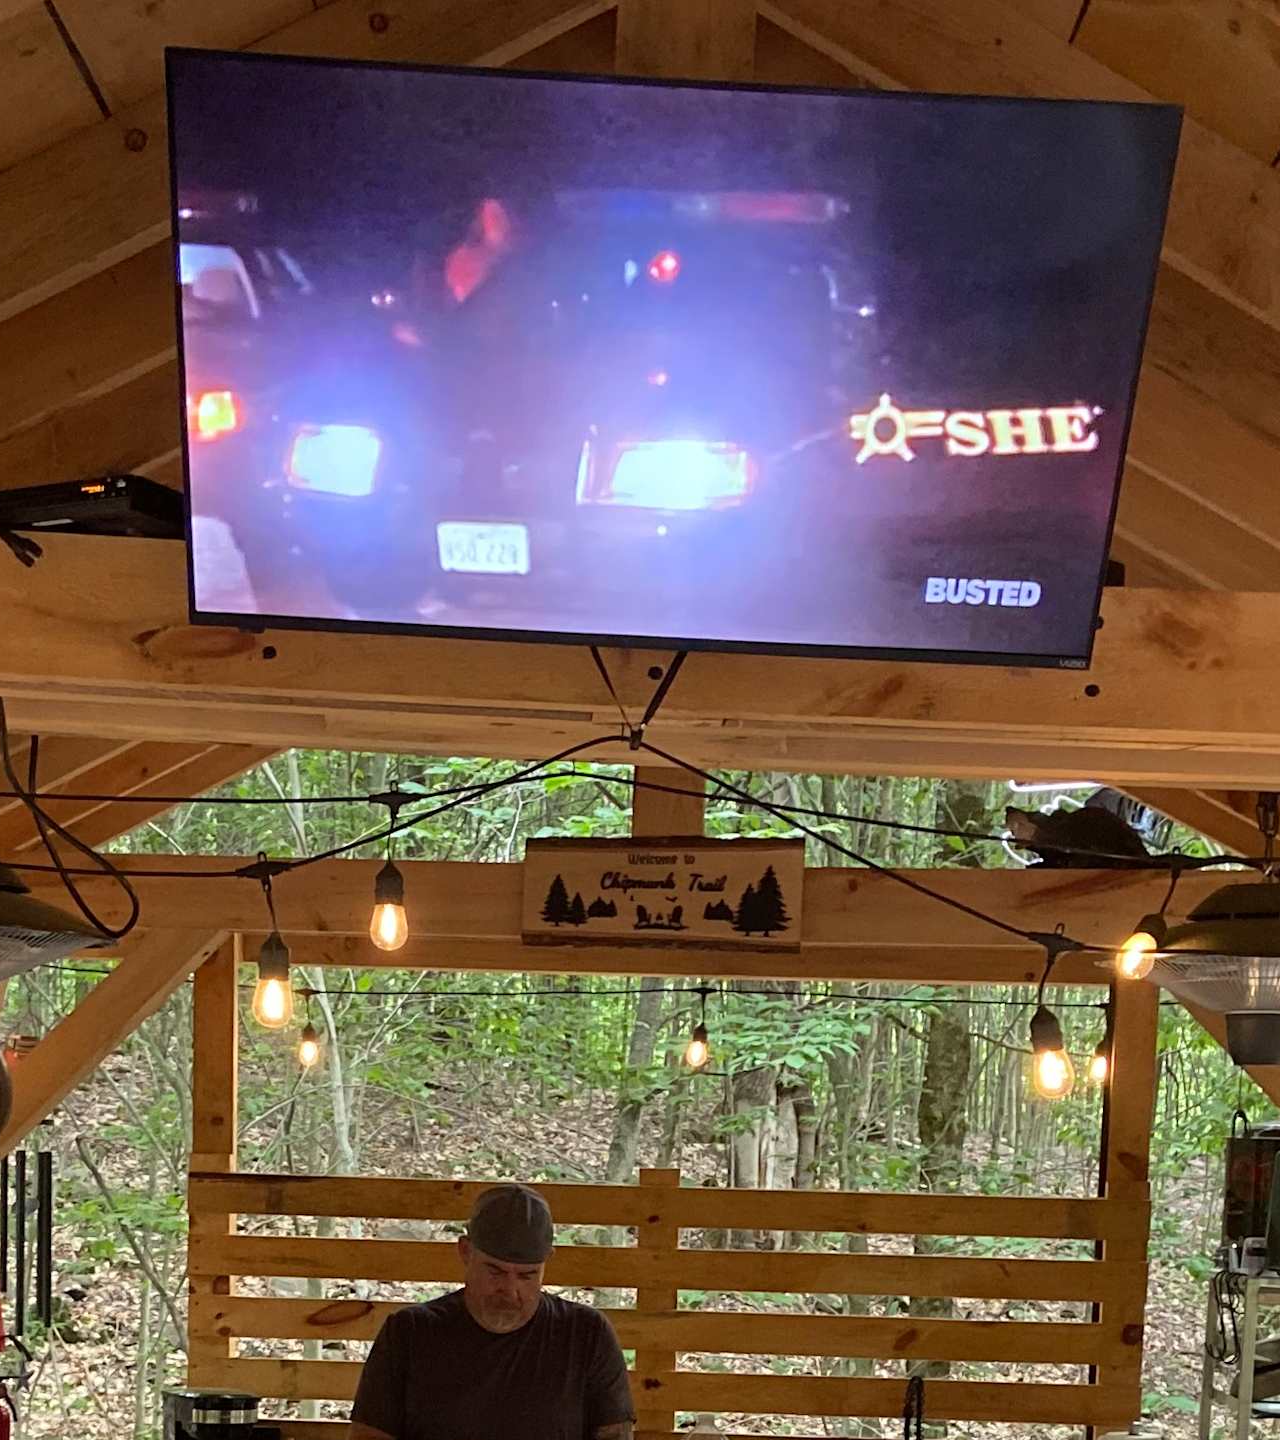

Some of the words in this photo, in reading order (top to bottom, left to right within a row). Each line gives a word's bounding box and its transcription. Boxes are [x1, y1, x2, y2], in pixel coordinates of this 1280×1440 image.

[944, 405, 1099, 457] SHE
[924, 576, 1042, 608] BUSTED
[627, 853, 678, 865] Welcome
[683, 853, 696, 865] to
[600, 871, 676, 894] Chipmunk
[688, 872, 728, 892] Trail
